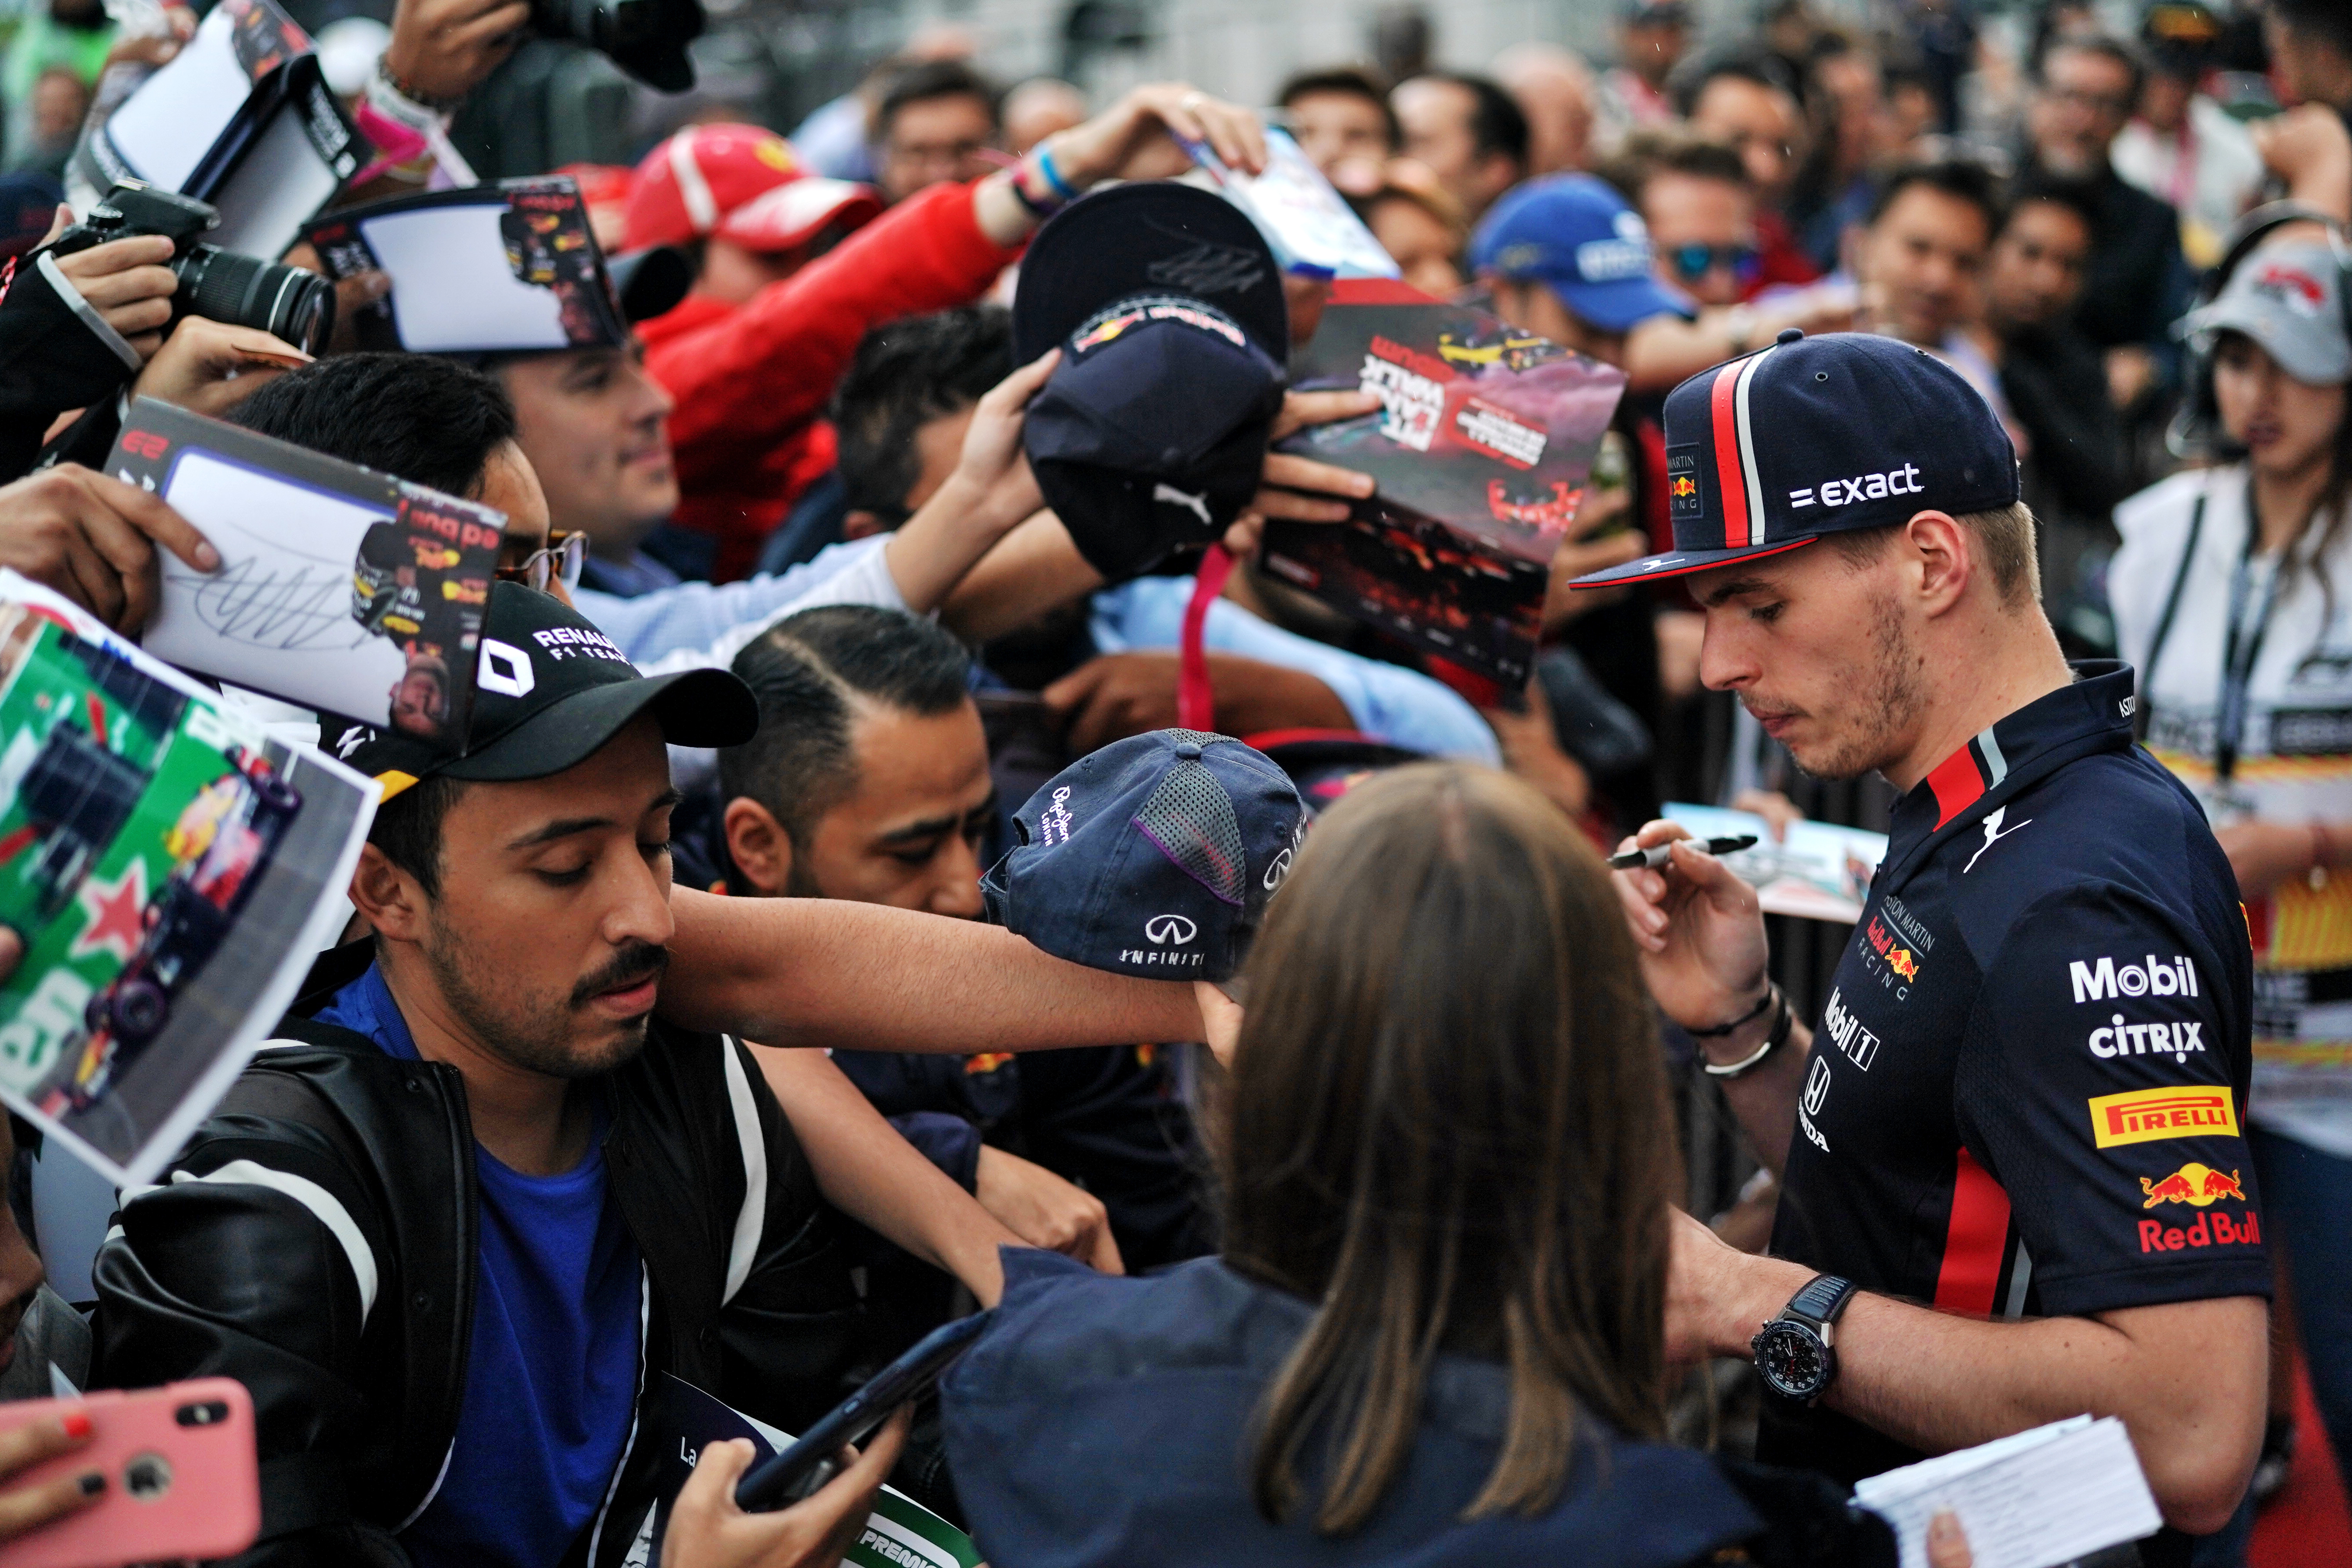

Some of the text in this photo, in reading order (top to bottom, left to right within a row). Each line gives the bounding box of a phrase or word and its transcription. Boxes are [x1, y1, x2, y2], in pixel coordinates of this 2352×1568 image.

[550, 646, 577, 661] F1
[1041, 812, 1053, 847] LONDON
[1900, 912, 1935, 952] MARTIN
[1120, 950, 1205, 966] INFINITI
[1858, 937, 1908, 1001] RACING
[2069, 955, 2198, 1003] Mobil
[1824, 986, 1858, 1052] Mobil
[2105, 1096, 2228, 1135] PIRELLI
[2138, 1211, 2261, 1253] Red Bull
[680, 1436, 697, 1468] La
[859, 1530, 938, 1568] PREMI
